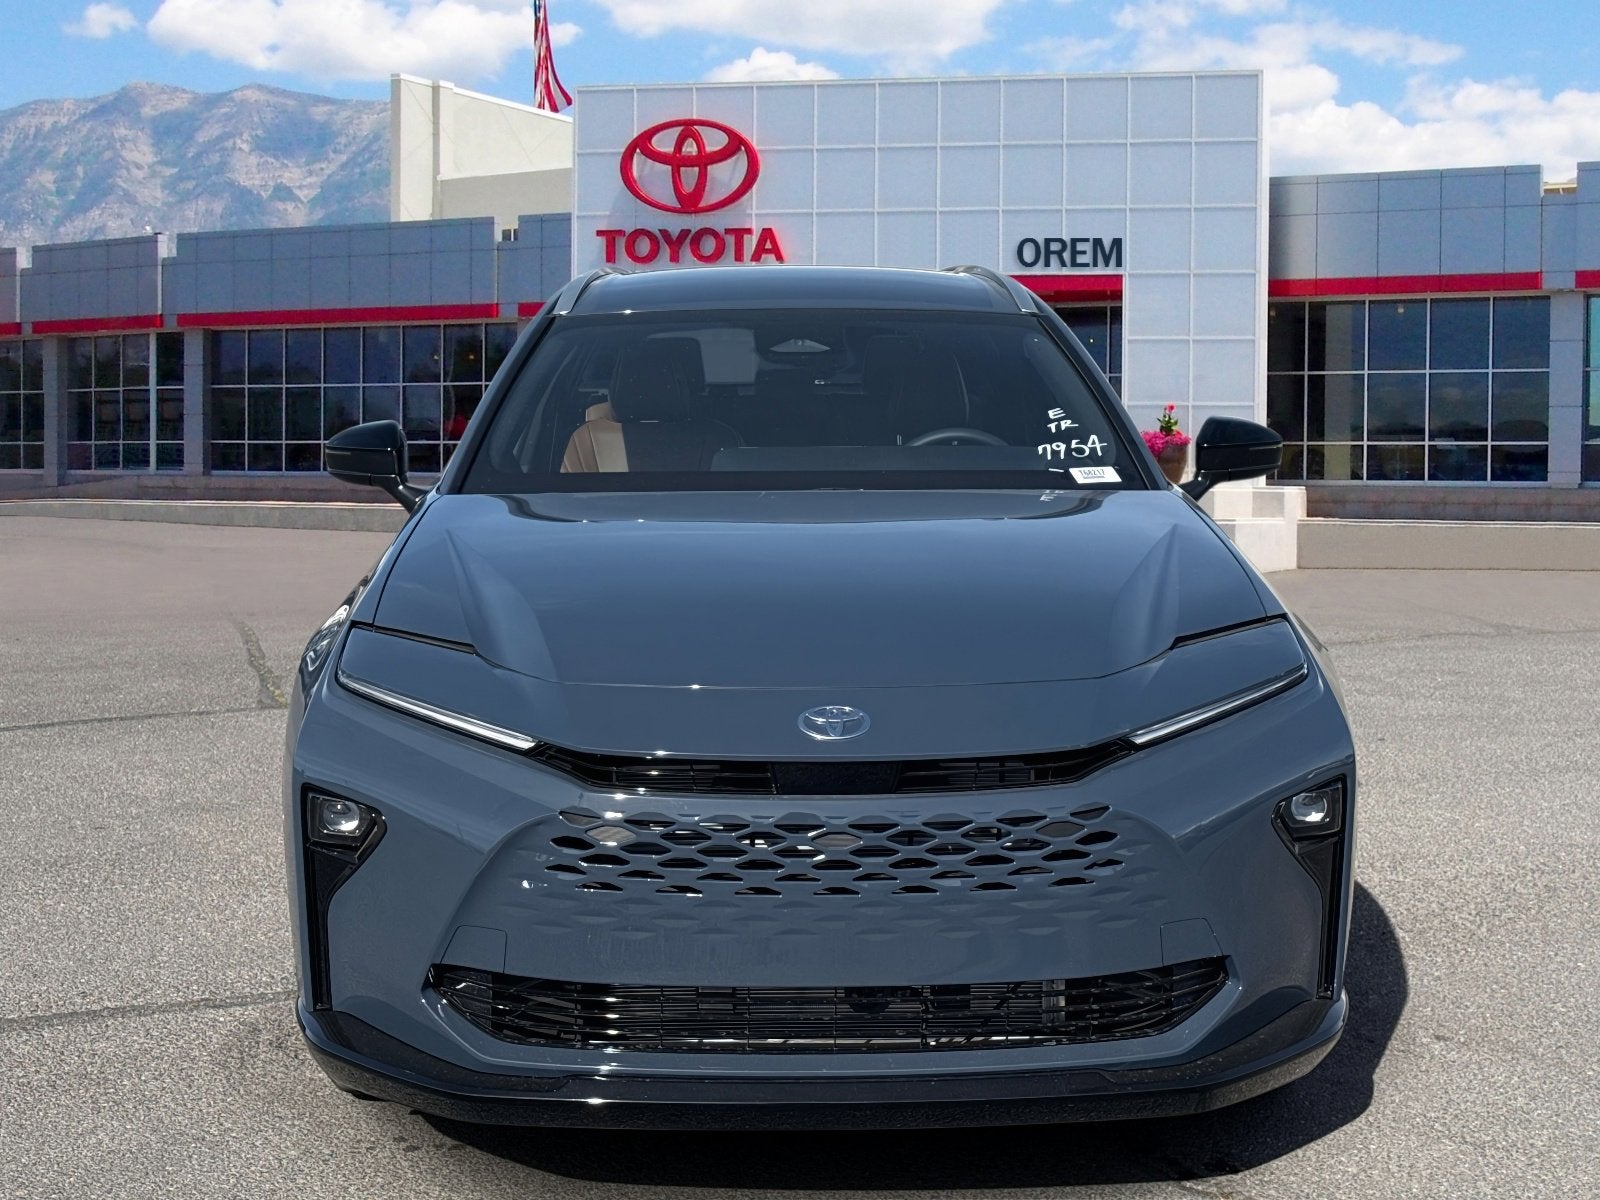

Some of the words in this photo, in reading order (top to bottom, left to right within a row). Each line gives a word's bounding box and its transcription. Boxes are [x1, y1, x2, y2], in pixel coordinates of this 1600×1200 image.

[596, 227, 785, 265] TOYOTA
[1017, 237, 1123, 268] OREM
[1047, 420, 1079, 433] TR
[1048, 408, 1066, 419] E
[1037, 434, 1108, 461] 7954
